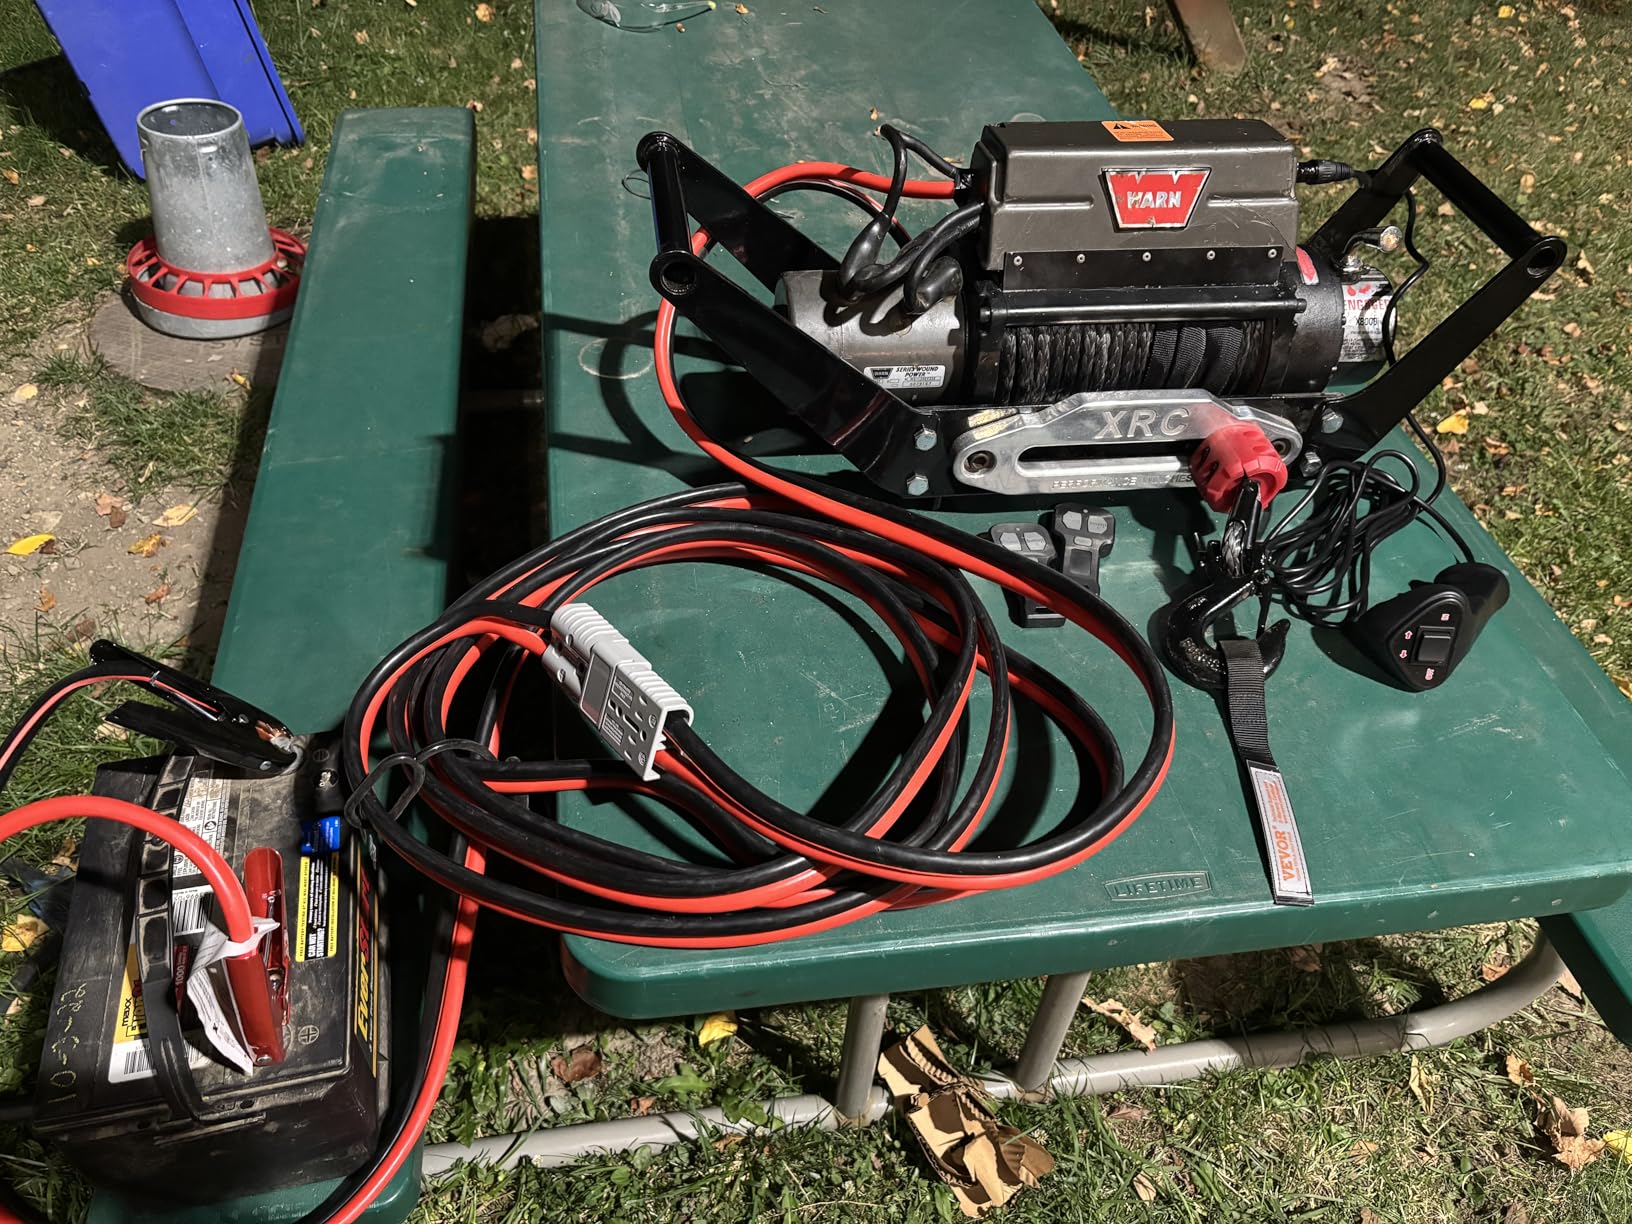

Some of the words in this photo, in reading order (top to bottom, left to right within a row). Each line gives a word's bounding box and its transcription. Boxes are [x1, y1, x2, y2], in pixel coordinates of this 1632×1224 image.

[1126, 191, 1182, 209] WARN
[1094, 408, 1190, 439] XRC
[1274, 830, 1295, 881] VEVOR
[1114, 878, 1203, 897] LIFETIME
[309, 933, 317, 945] NOT
[316, 927, 325, 958] STARTING?
[308, 945, 316, 958] CAR
[175, 965, 184, 985] 1000
[122, 997, 131, 1027] maxx
